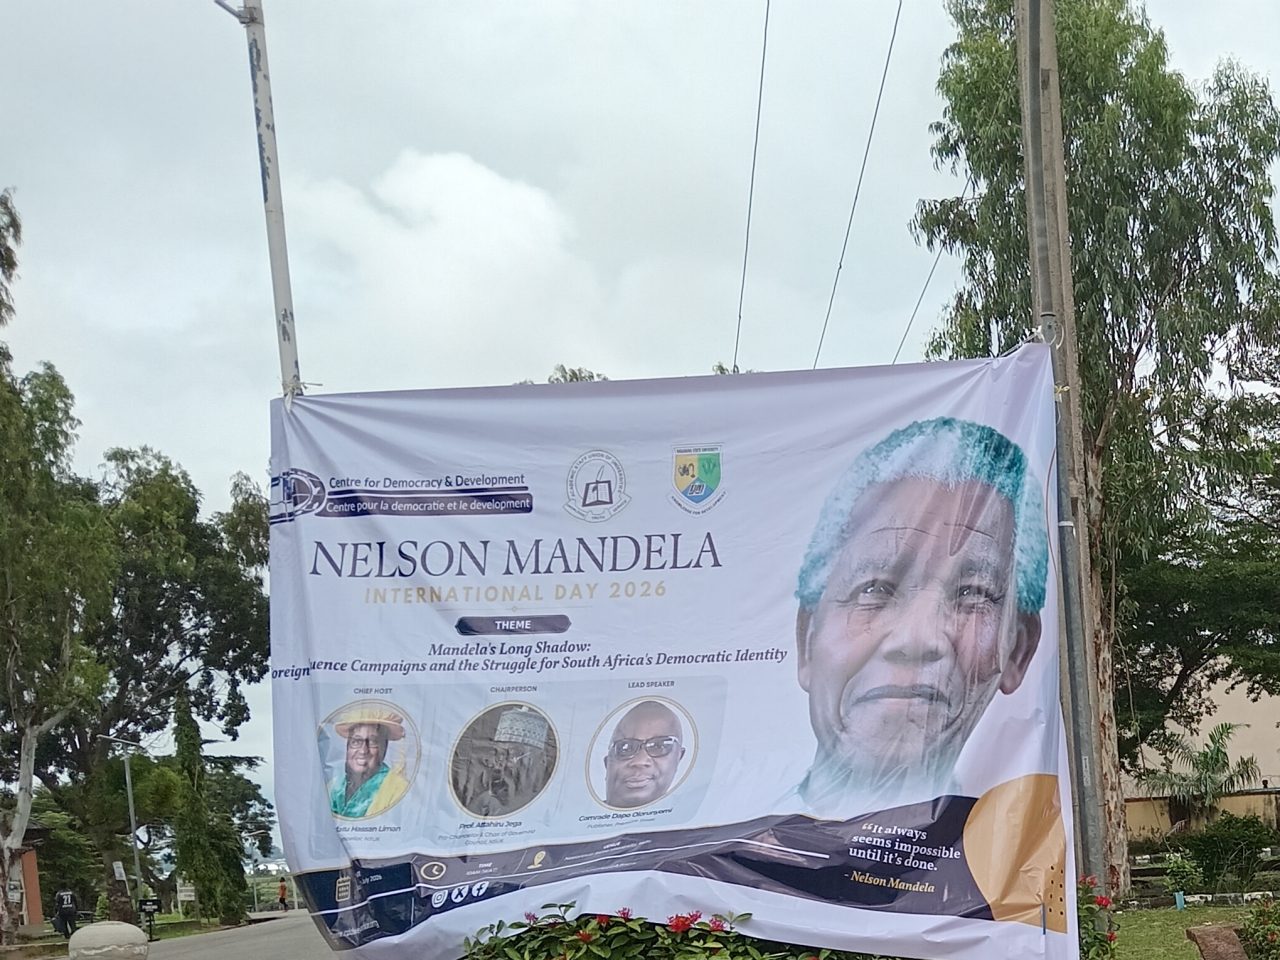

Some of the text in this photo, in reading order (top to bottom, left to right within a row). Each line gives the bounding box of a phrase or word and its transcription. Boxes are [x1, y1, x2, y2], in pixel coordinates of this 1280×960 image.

[329, 474, 525, 489] Centre for Democracy & Development
[326, 498, 530, 512] Centre pour la democratie et le development
[309, 531, 722, 578] NELSON MANDELA
[364, 580, 667, 604] INTERNATIONAL DAY 2026
[495, 619, 531, 630] THEME
[428, 640, 591, 658] Mandela's Long Shadow:
[271, 664, 310, 681] oreign
[350, 658, 426, 675] Campaigns
[429, 658, 455, 671] and
[458, 657, 479, 671] the
[481, 656, 537, 673] Struggle
[537, 654, 559, 674] for
[561, 653, 601, 669] South
[603, 652, 653, 670] Africa's
[656, 649, 732, 665] Democratic
[735, 647, 787, 663] Identity
[353, 687, 393, 695] CHIEF HOST
[490, 685, 537, 694] CHAIRPERSON
[628, 680, 675, 689] LEAD SPEAKER
[884, 825, 928, 842] always
[851, 835, 961, 860] seems impossible
[848, 847, 881, 862] until
[904, 855, 938, 871] done.
[850, 870, 887, 887] Nelson
[887, 877, 935, 893] Mandela
